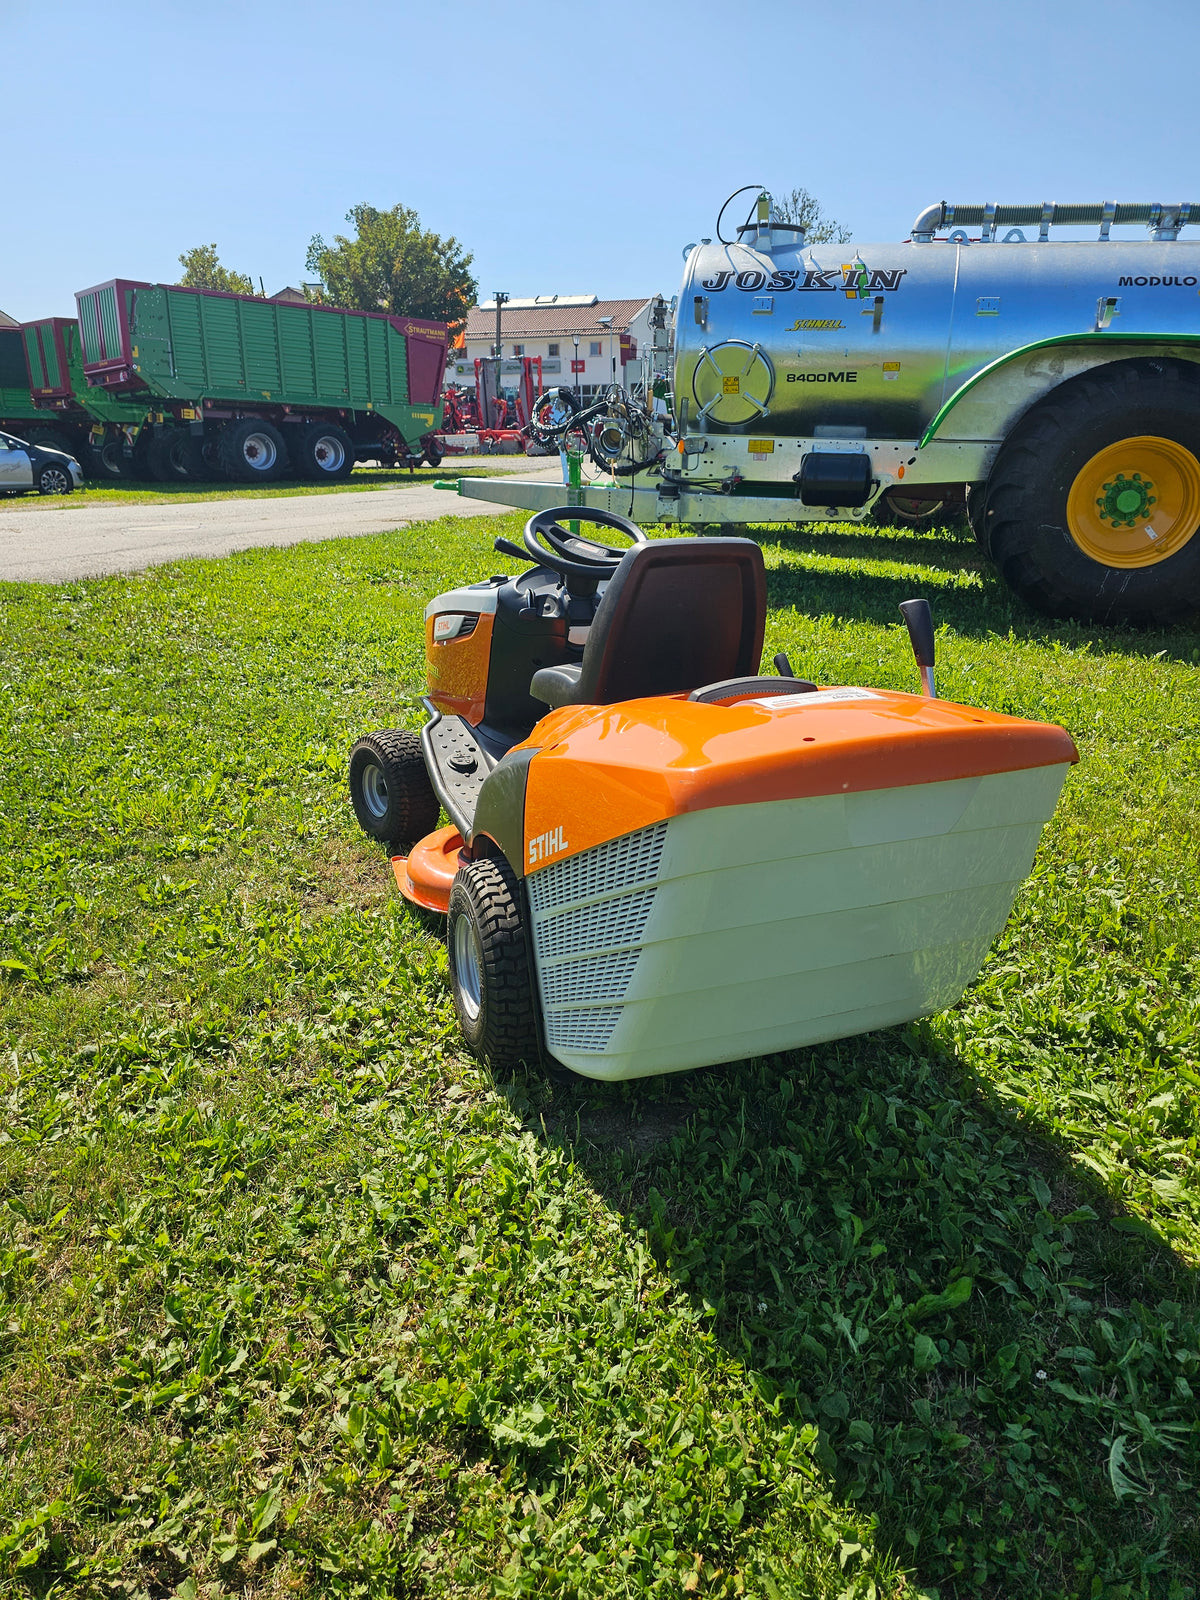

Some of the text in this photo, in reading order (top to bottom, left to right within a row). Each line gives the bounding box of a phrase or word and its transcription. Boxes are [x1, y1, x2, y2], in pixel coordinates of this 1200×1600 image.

[702, 270, 907, 292] JOSKIN
[1118, 276, 1198, 287] MODULO
[408, 325, 446, 337] STRAUTMANN
[786, 319, 846, 331] SCHNELL
[786, 371, 858, 383] 8400ME
[529, 825, 569, 865] STIHL
